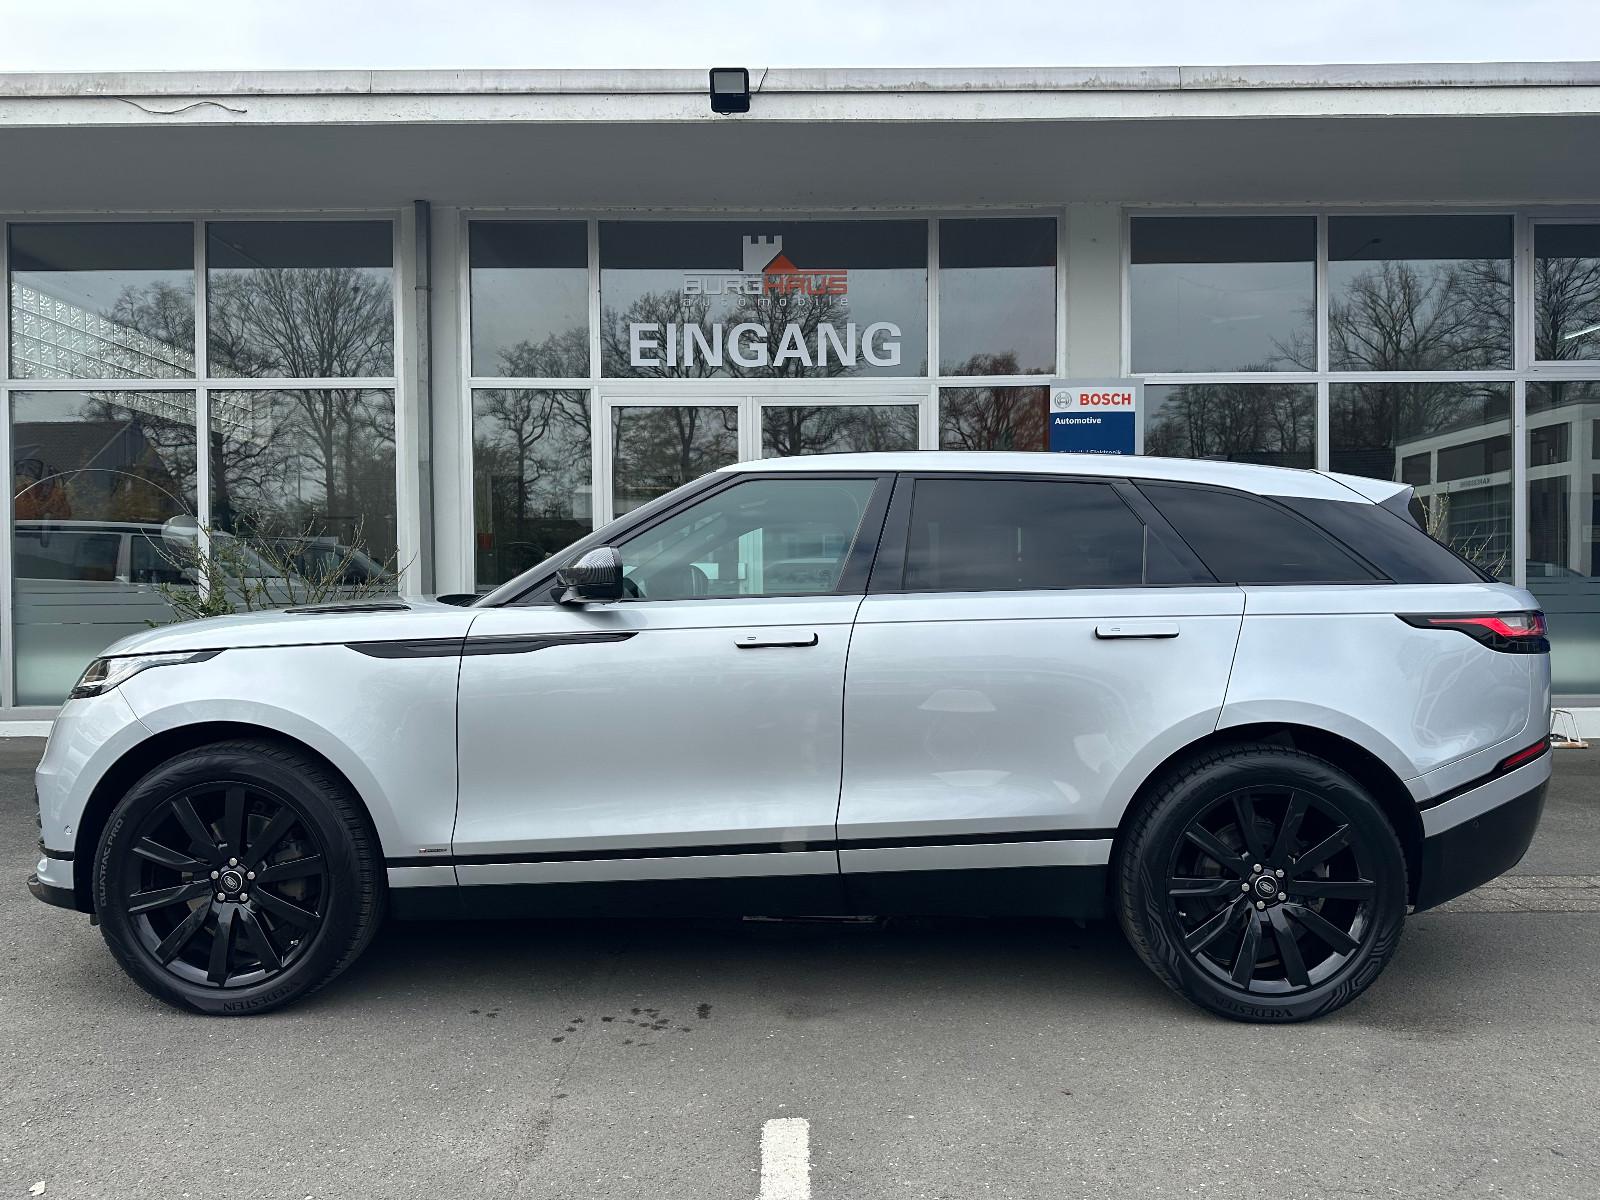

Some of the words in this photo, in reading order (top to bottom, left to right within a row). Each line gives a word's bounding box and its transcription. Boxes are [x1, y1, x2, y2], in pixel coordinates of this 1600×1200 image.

[683, 276, 848, 295] BURGHAUS
[629, 321, 901, 367] EINGANG
[1080, 393, 1131, 405] BOSCH
[1055, 416, 1102, 425] Automotive
[108, 817, 124, 846] PRO
